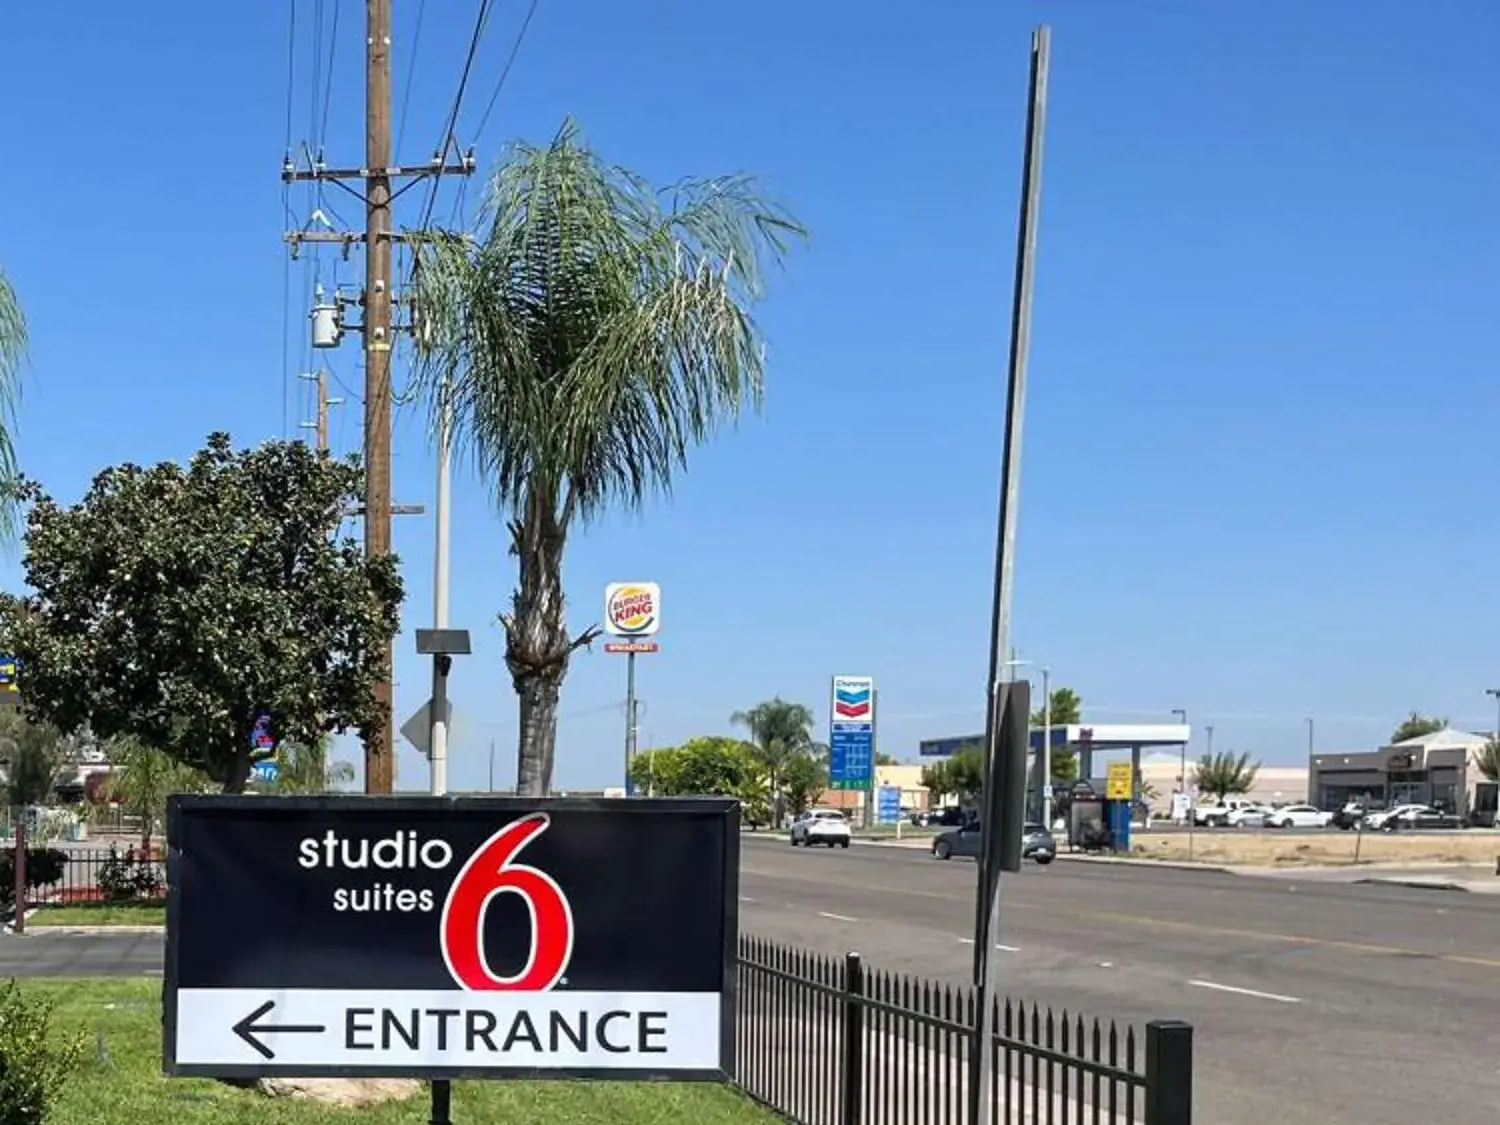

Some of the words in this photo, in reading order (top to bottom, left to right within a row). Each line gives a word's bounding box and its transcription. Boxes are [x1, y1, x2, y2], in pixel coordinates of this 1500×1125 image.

[615, 602, 652, 622] KING
[299, 829, 452, 869] studio
[333, 885, 434, 912] suites
[440, 812, 574, 992] 6
[344, 1007, 668, 1054] ENTRANCE
